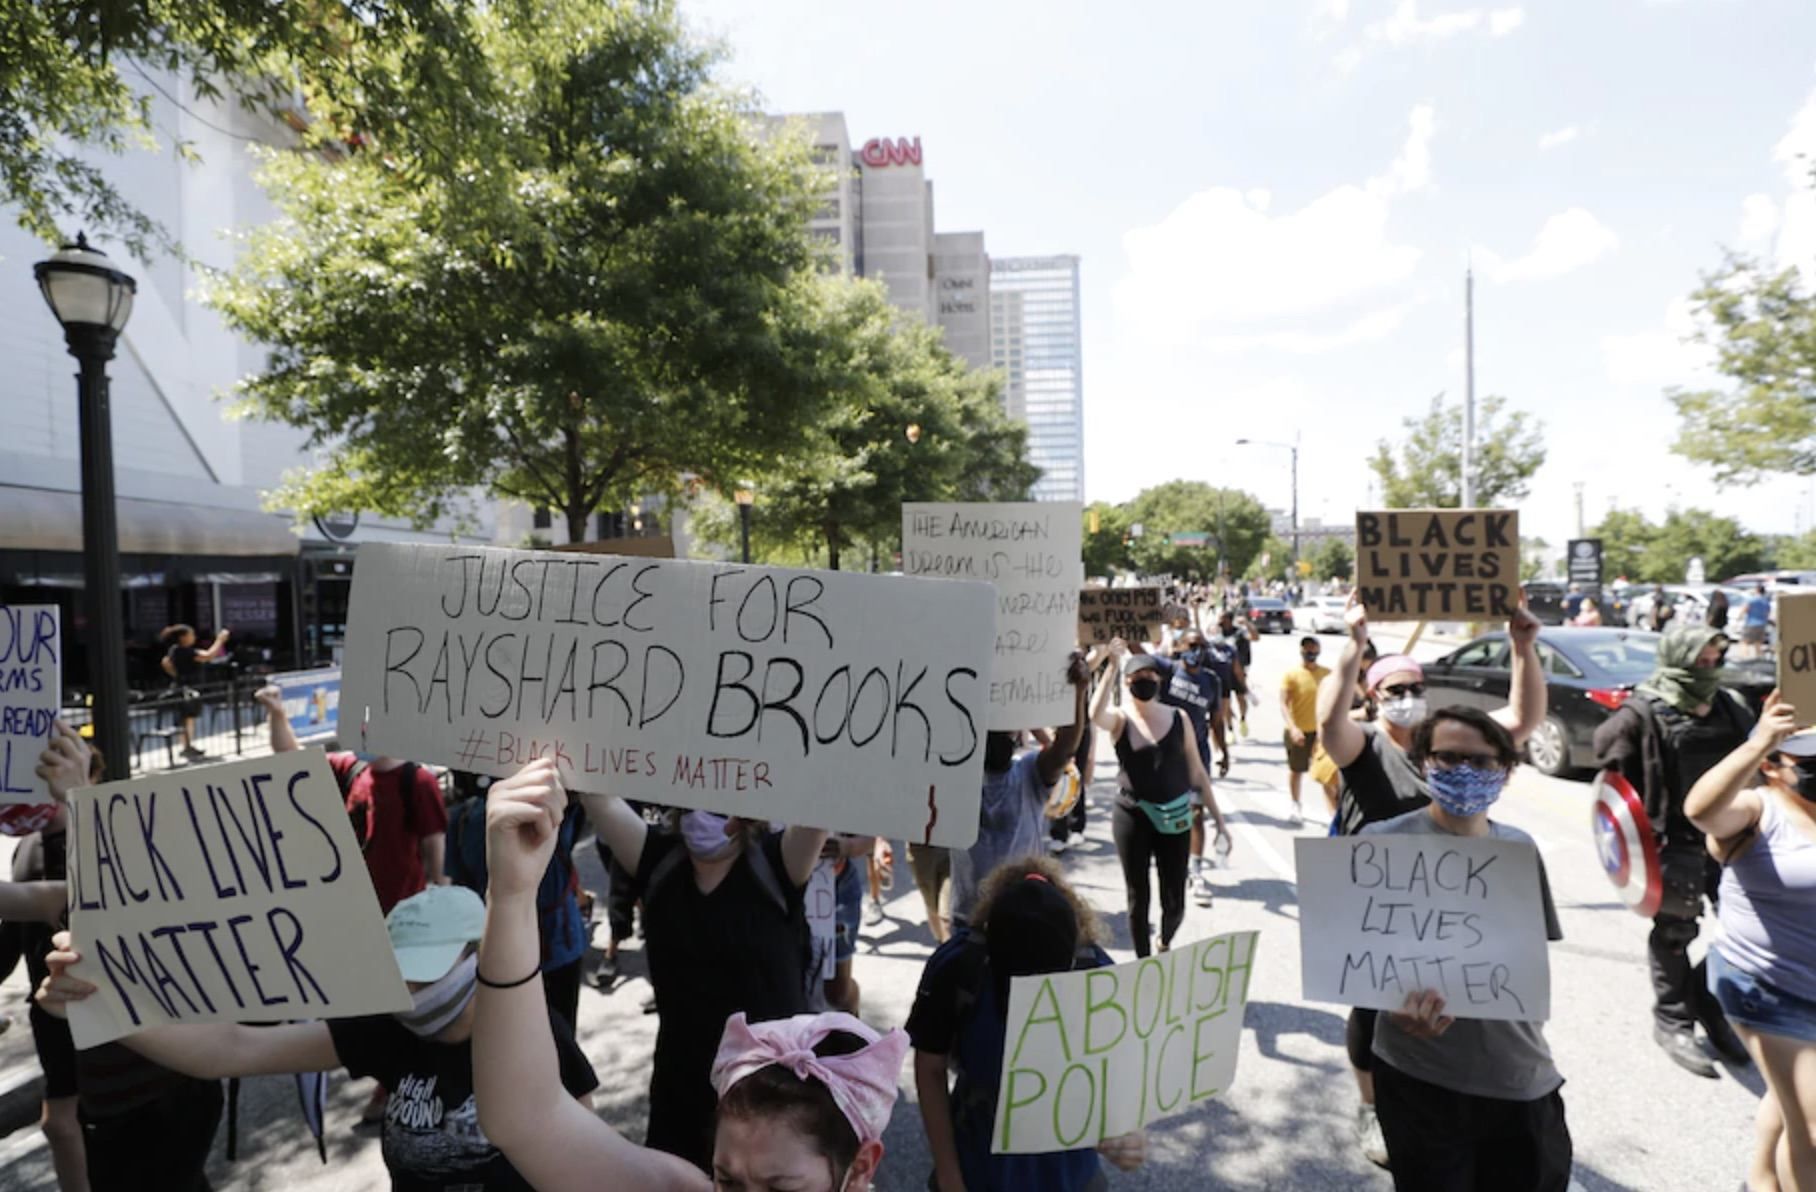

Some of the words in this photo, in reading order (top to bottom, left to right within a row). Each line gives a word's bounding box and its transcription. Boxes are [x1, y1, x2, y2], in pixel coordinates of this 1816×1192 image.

[862, 136, 923, 168] CNN
[1358, 512, 1511, 548] BLACK
[1370, 551, 1501, 579] LIVES
[440, 554, 661, 633] JUSTICE
[708, 569, 835, 650] FOR
[1360, 583, 1515, 617] MATTER
[383, 625, 685, 731] RAYSHARD
[706, 650, 978, 767] BROOKS
[584, 742, 658, 778] LIVES
[671, 753, 774, 792] MATTER
[181, 770, 342, 900] LIVES
[1350, 840, 1499, 899] BLACK
[1360, 895, 1483, 949] LIVES
[95, 906, 331, 1026] MATTER
[1338, 951, 1526, 1015] MATTER
[1009, 931, 1260, 1068] ABOLISH
[1001, 1008, 1228, 1152] POLICE
